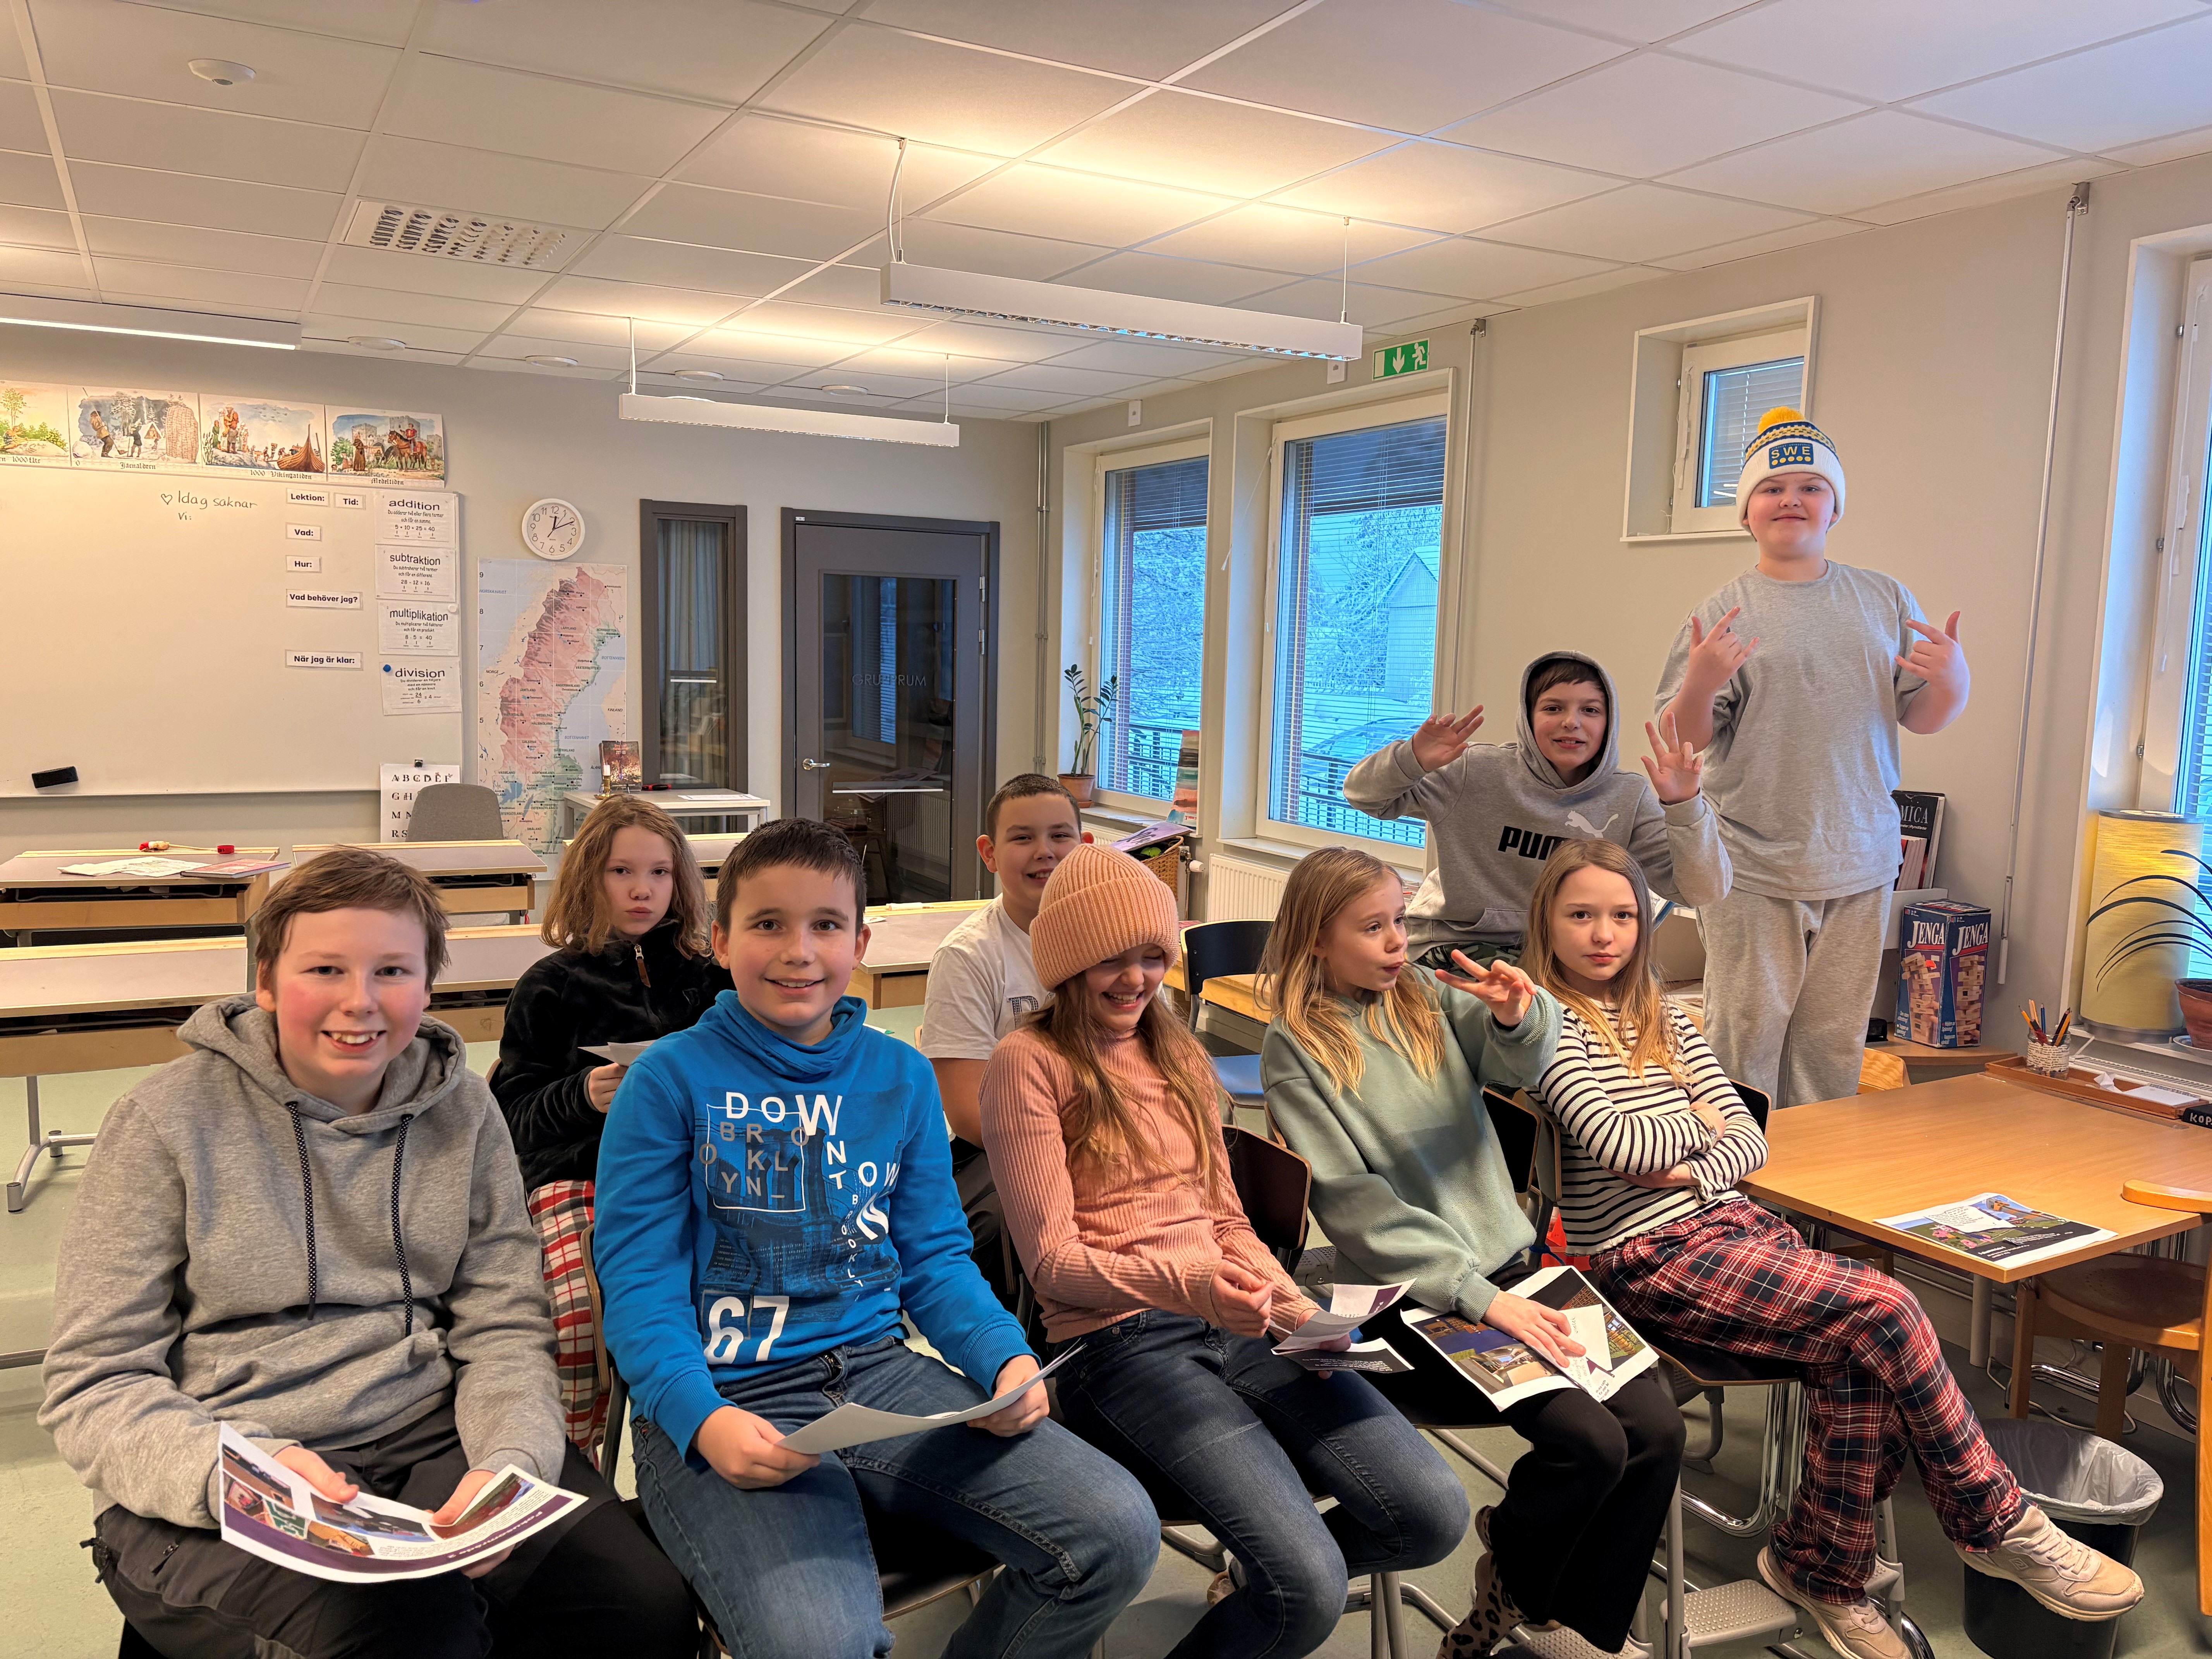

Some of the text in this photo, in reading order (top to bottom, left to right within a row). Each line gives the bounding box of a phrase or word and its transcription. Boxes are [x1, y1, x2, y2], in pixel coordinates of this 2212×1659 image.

[1771, 446, 1810, 459] SWE
[178, 490, 258, 510] Idag saknar
[291, 493, 325, 502] Lektion:
[389, 499, 440, 510] addition
[551, 506, 559, 514] 12
[532, 513, 540, 522] 10
[570, 517, 575, 526] 2
[532, 533, 538, 541] 8
[571, 527, 577, 536] 3
[390, 553, 440, 565] subtraktion
[390, 608, 448, 621] multiplikation
[395, 668, 445, 678] division
[852, 674, 926, 687] GRUPPRUM
[435, 774, 441, 782] E
[1901, 805, 1928, 824] MICA
[1907, 921, 1945, 948] JENGA
[1952, 922, 1988, 956] JENGA
[2190, 1113, 2212, 1125] KOP
[704, 1296, 789, 1365] 67
